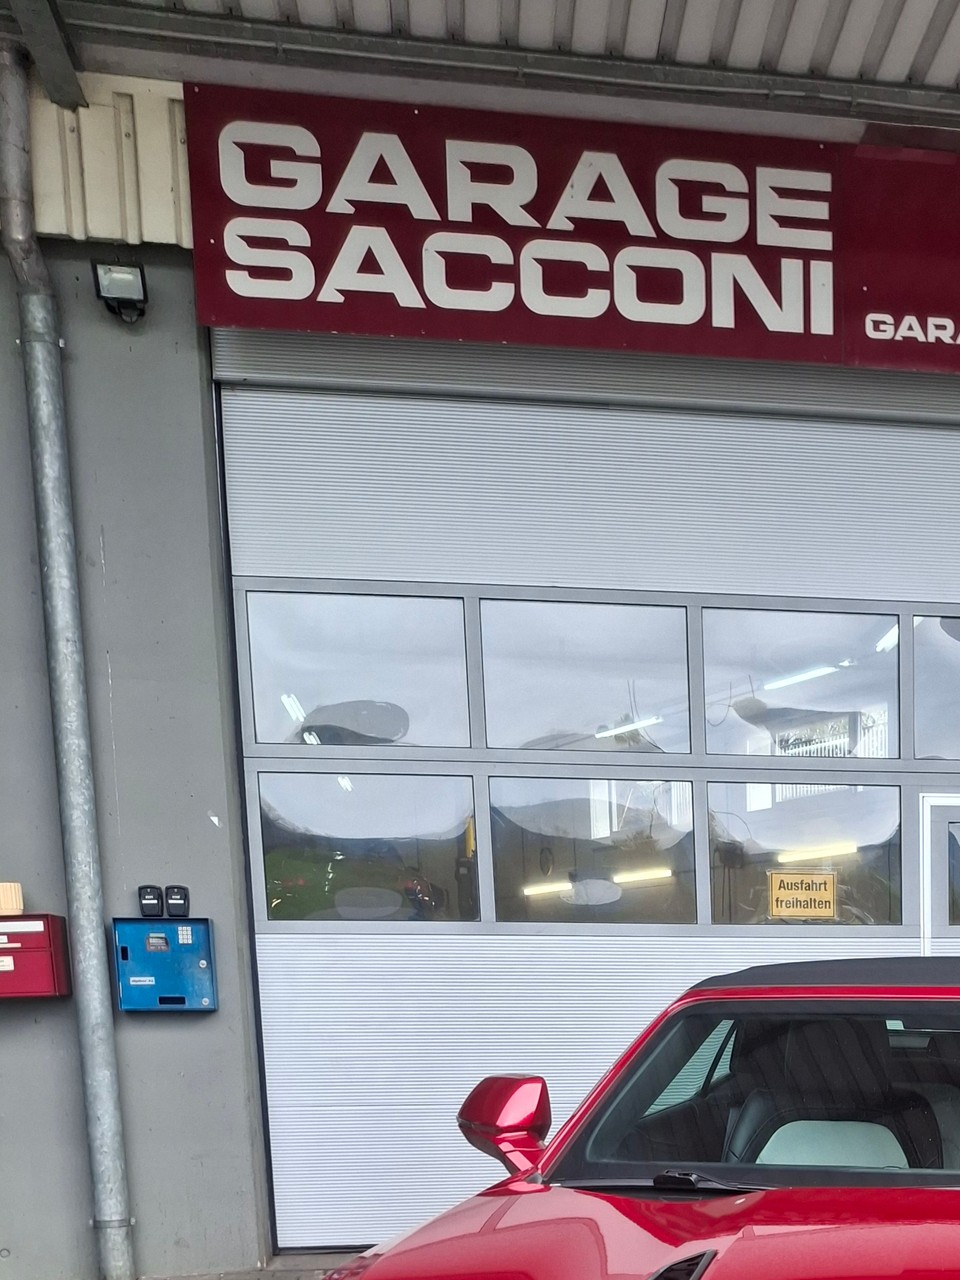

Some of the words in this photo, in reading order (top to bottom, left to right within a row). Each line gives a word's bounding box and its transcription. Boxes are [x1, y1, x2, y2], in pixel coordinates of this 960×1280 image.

[218, 120, 833, 251] GARAGE
[223, 216, 834, 336] SACCONI
[775, 897, 831, 910] freihalten
[778, 879, 828, 892] Ausfahrt
